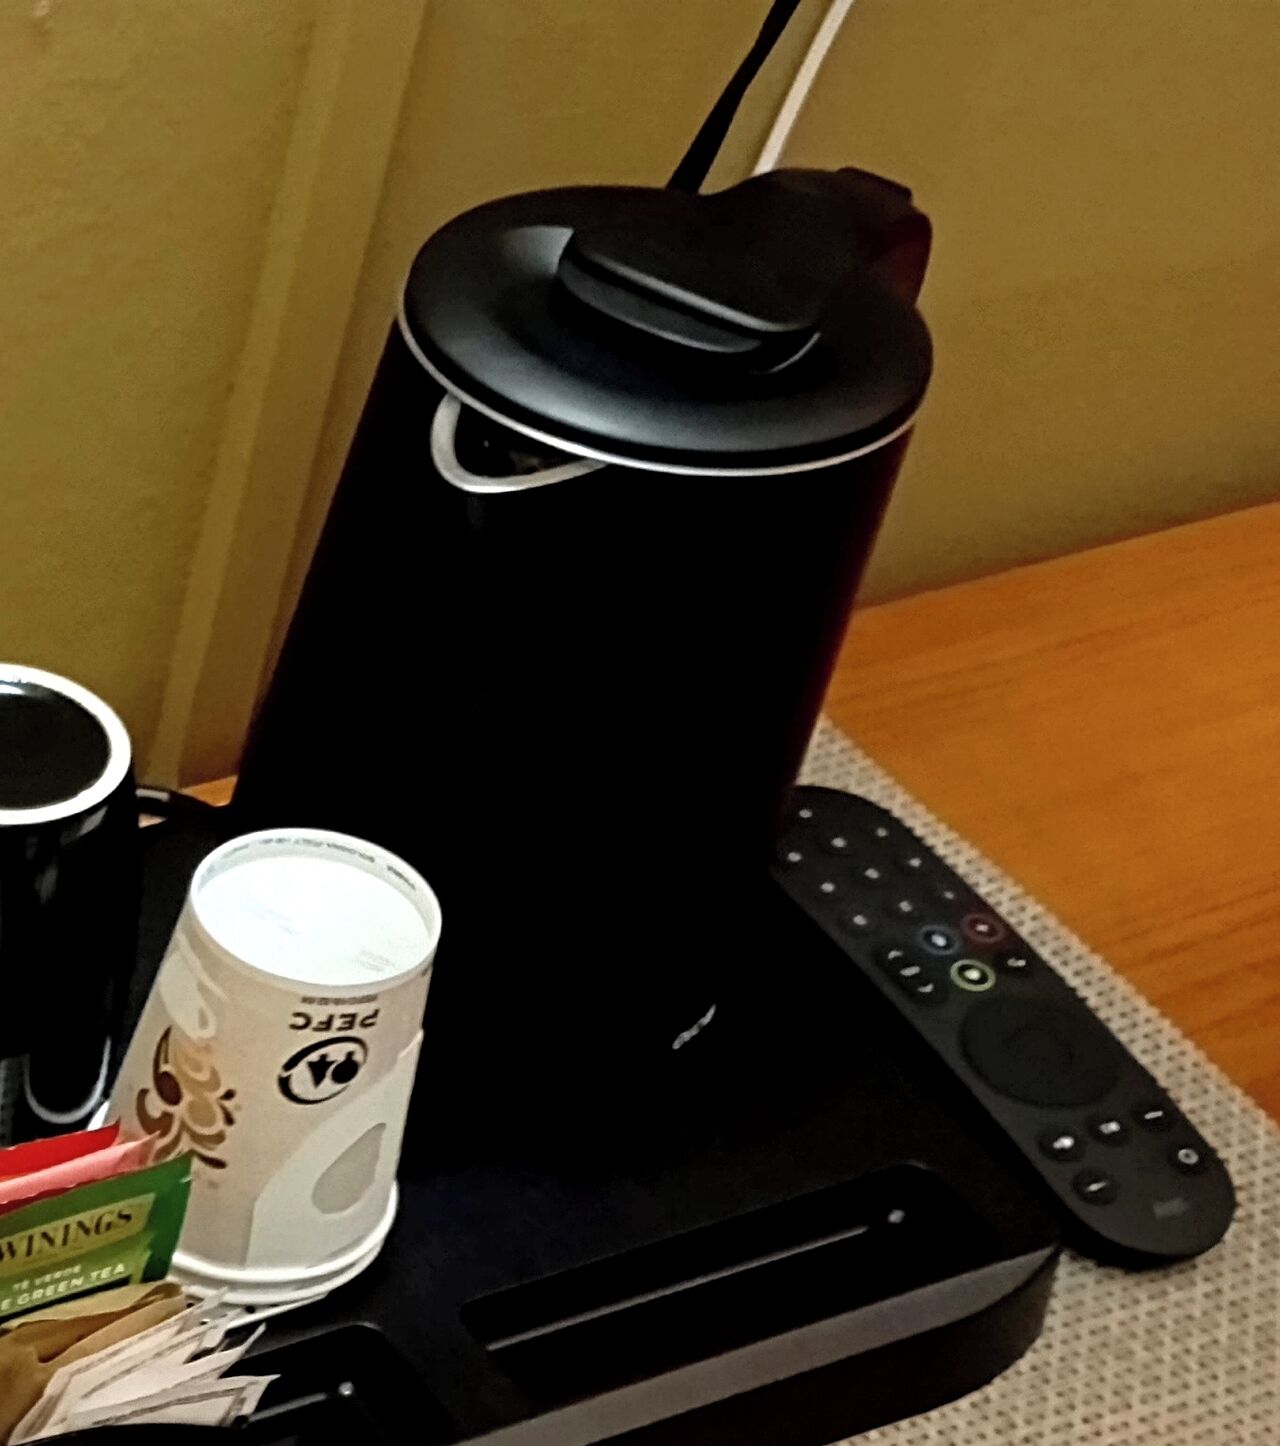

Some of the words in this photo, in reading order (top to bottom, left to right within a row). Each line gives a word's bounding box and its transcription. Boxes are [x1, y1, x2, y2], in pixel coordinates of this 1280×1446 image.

[289, 1008, 378, 1032] PEFC
[15, 1275, 81, 1305] GREEN
[87, 1263, 125, 1286] TEA
